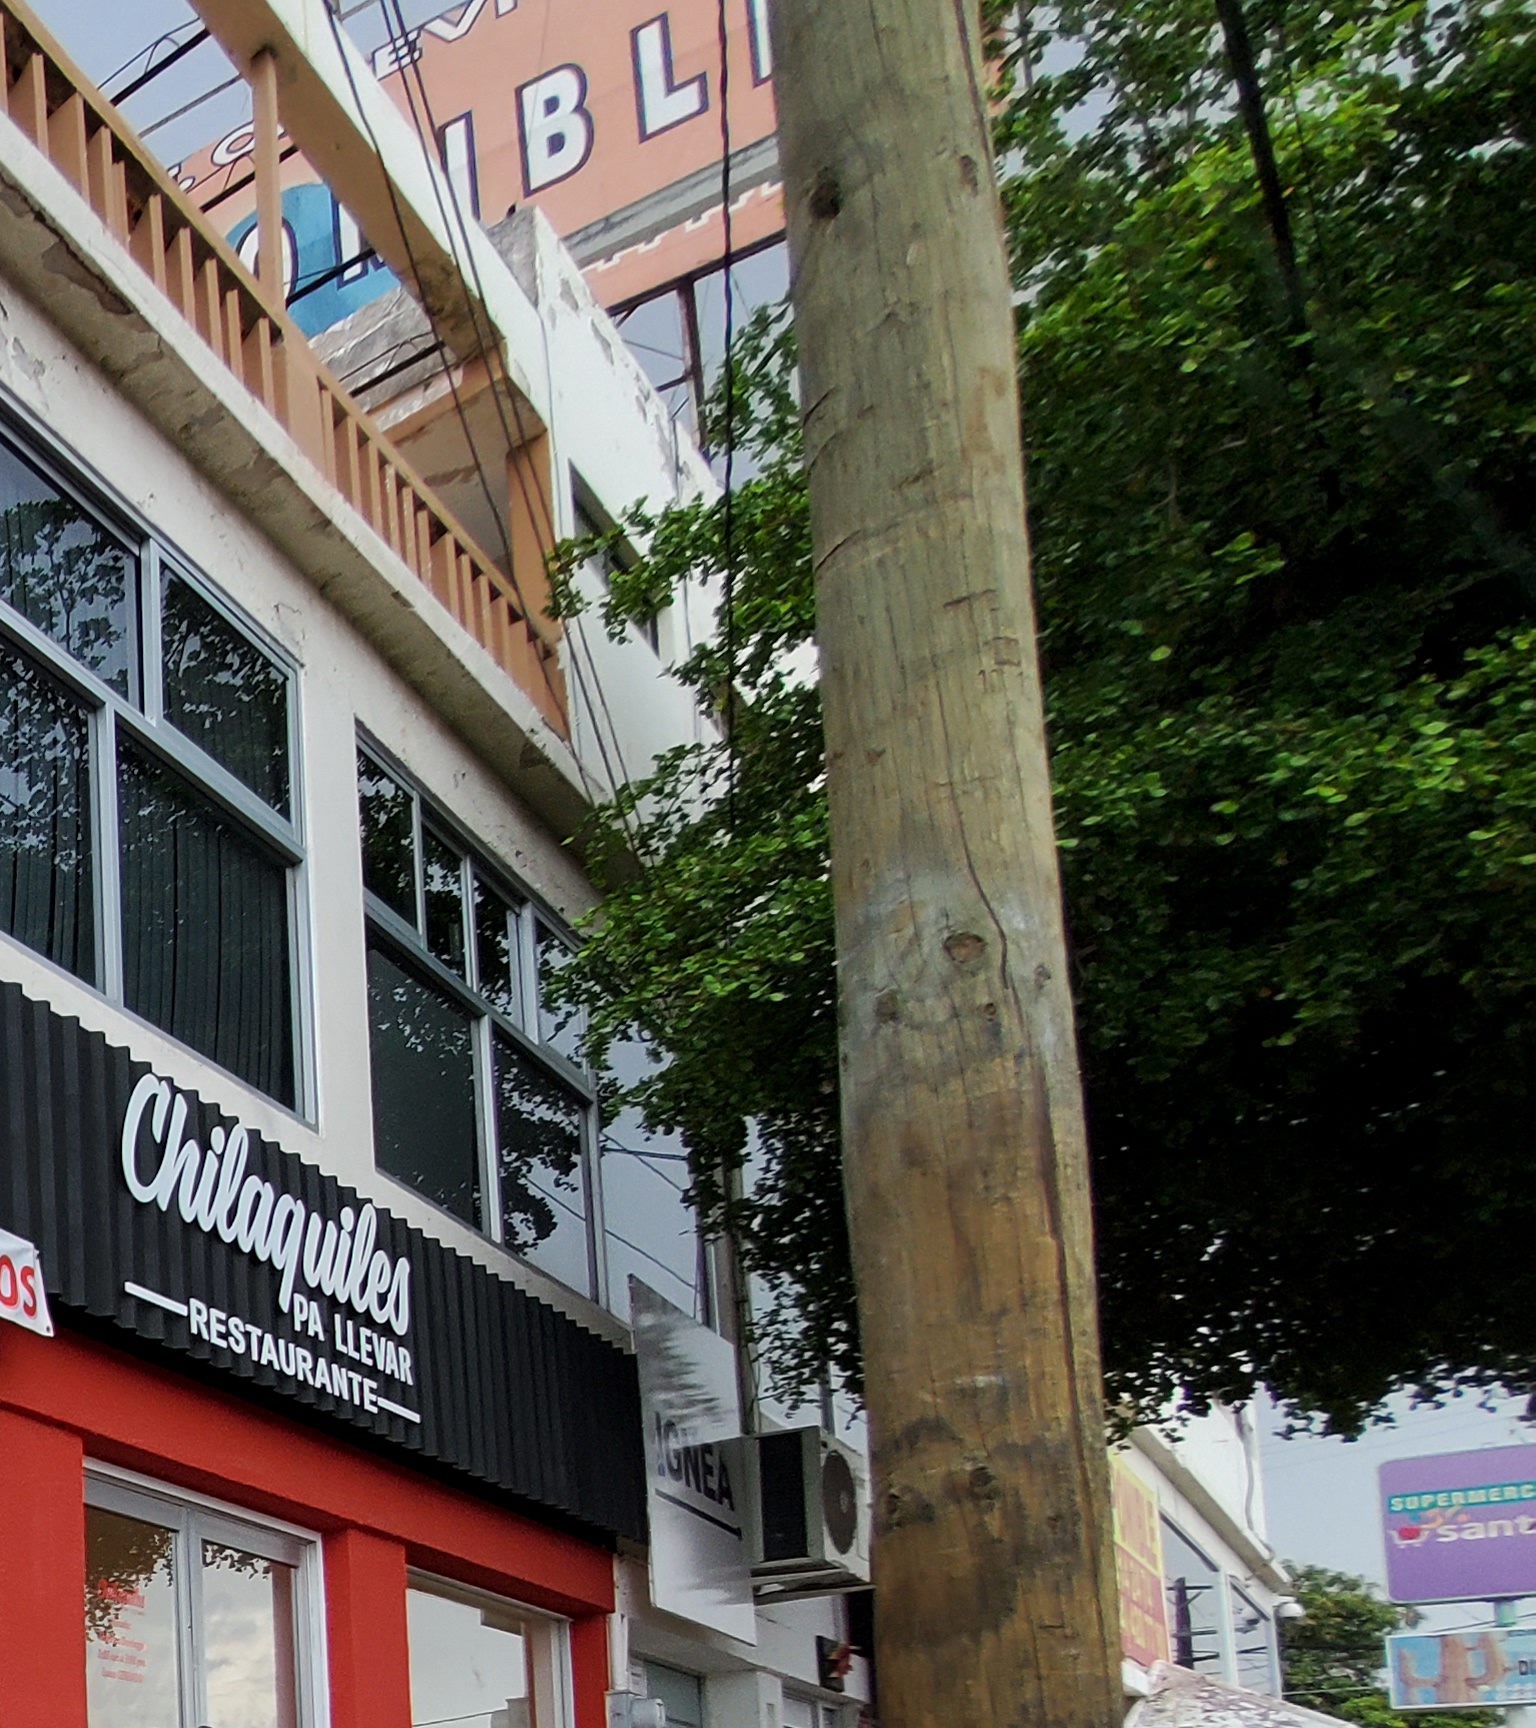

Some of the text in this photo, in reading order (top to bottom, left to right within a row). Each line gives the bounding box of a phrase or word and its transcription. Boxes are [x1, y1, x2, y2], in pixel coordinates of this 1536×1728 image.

[121, 1072, 411, 1336] Chilaquiles
[188, 1298, 379, 1415] RESTAURANTE
[293, 1293, 414, 1386] PA LLEVAR
